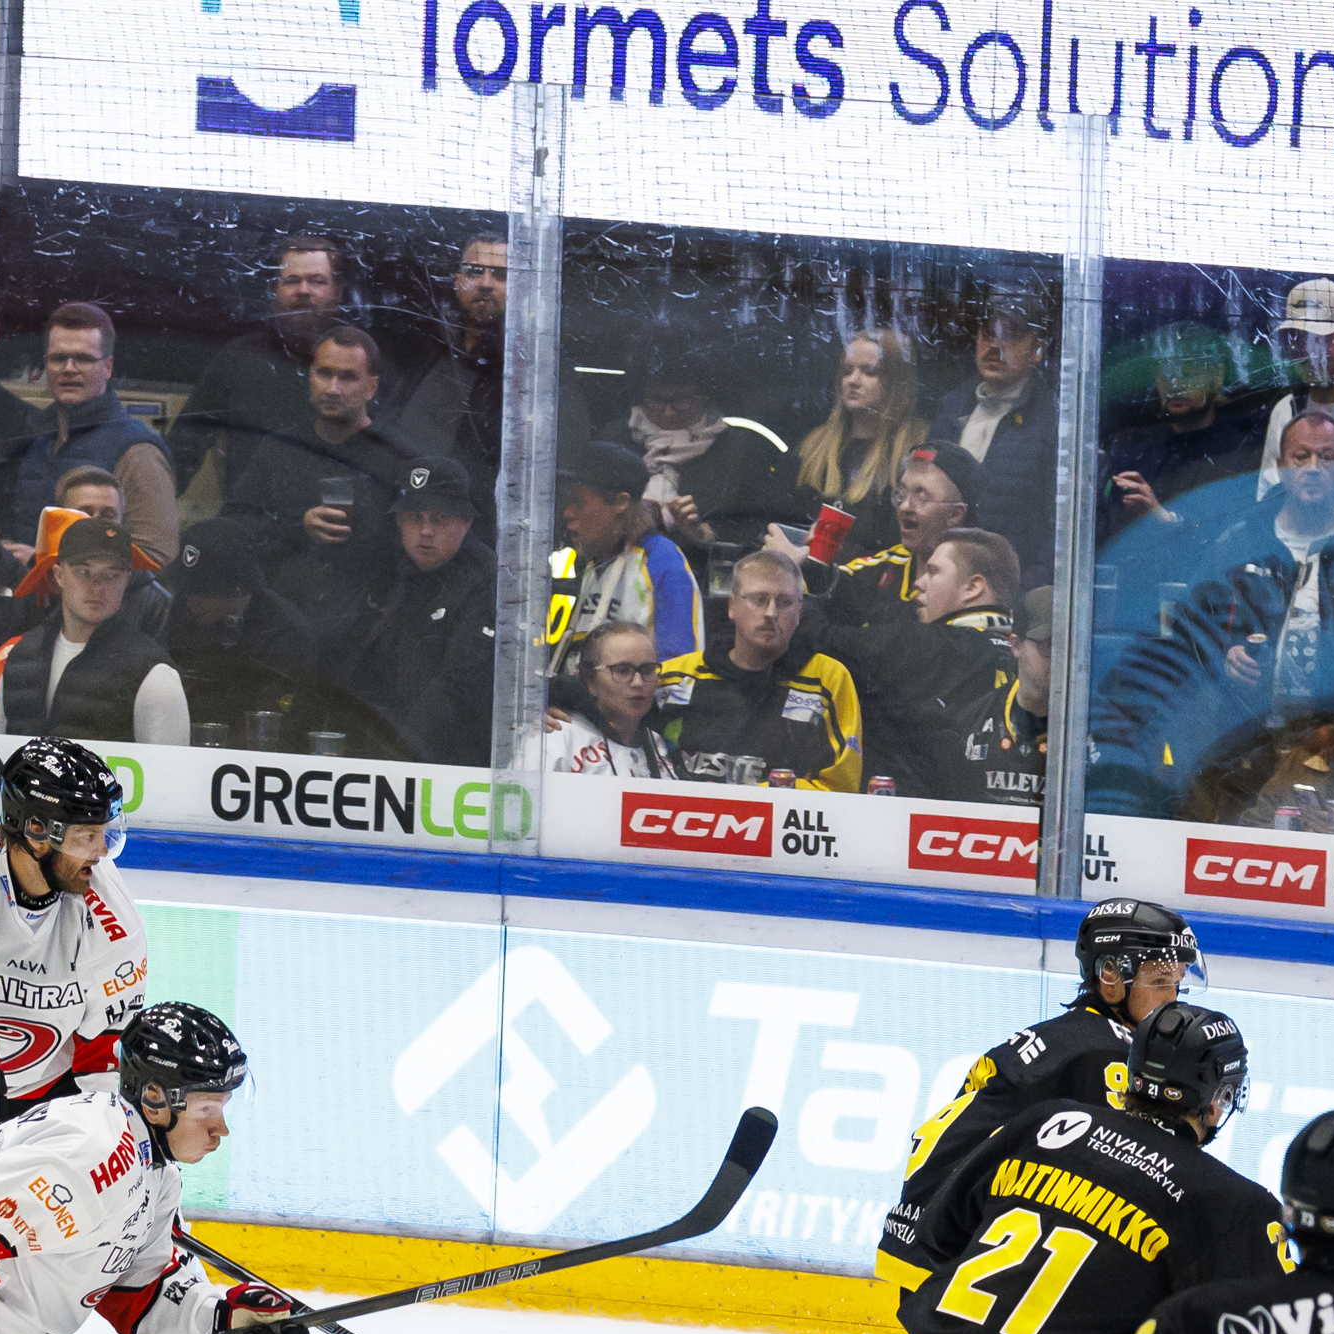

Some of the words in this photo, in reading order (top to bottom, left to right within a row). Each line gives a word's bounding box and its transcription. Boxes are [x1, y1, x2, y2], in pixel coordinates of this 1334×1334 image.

[210, 763, 532, 841] GREENLED
[628, 807, 766, 842] CCM
[782, 809, 830, 833] ALL
[781, 833, 839, 859] OUT.
[916, 829, 1039, 864] CCM
[1083, 835, 1111, 858] LL
[1082, 859, 1119, 884] UT.
[1191, 855, 1320, 891] CCM
[83, 887, 127, 942] RVIA
[1087, 902, 1135, 919] DISAS
[1094, 934, 1121, 944] CCM
[1202, 1020, 1237, 1041] DISAS
[89, 1122, 137, 1195] HARV
[1092, 1125, 1175, 1174] NIVALAN
[1086, 1136, 1185, 1203] TEOLLISUUSKYLÄ
[28, 1176, 80, 1240] ELONEN
[990, 1158, 1170, 1263] MATINMIKKO
[415, 1260, 543, 1304] BAUER
